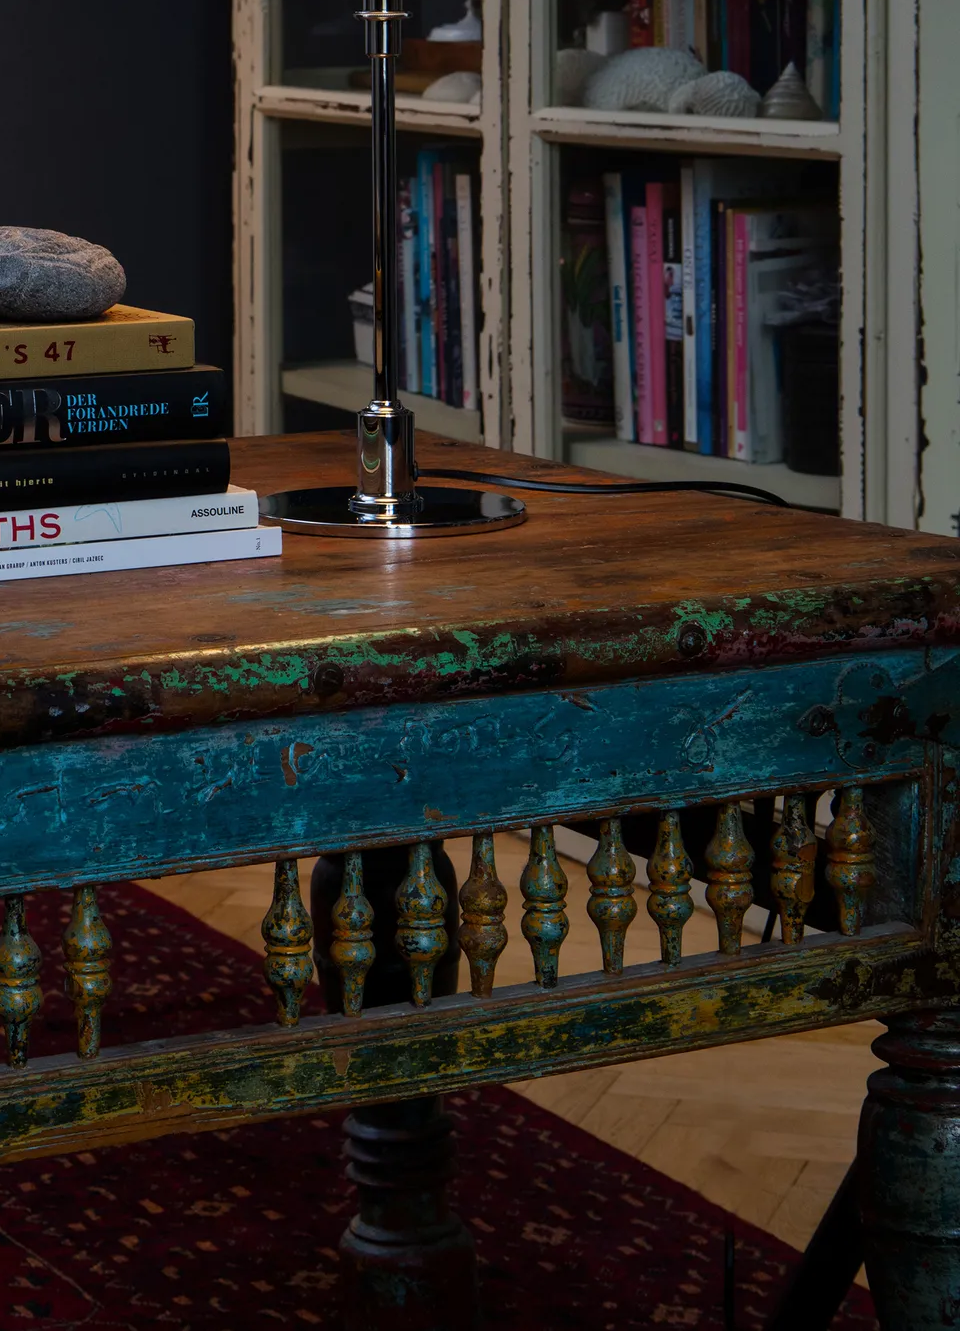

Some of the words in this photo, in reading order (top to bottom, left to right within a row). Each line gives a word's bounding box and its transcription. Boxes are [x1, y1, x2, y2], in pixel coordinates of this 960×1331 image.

[44, 340, 76, 362] 47
[66, 393, 97, 407] DER
[67, 402, 170, 420] FORANDREDE
[67, 419, 129, 434] VERDEN
[122, 467, 210, 479] GYLDENDAL
[15, 476, 54, 488] hjerte
[190, 505, 245, 518] ASSOULINE
[46, 558, 68, 566] KUSTERS
[72, 556, 85, 564] CIRIL
[85, 555, 104, 563] JAZBEC
